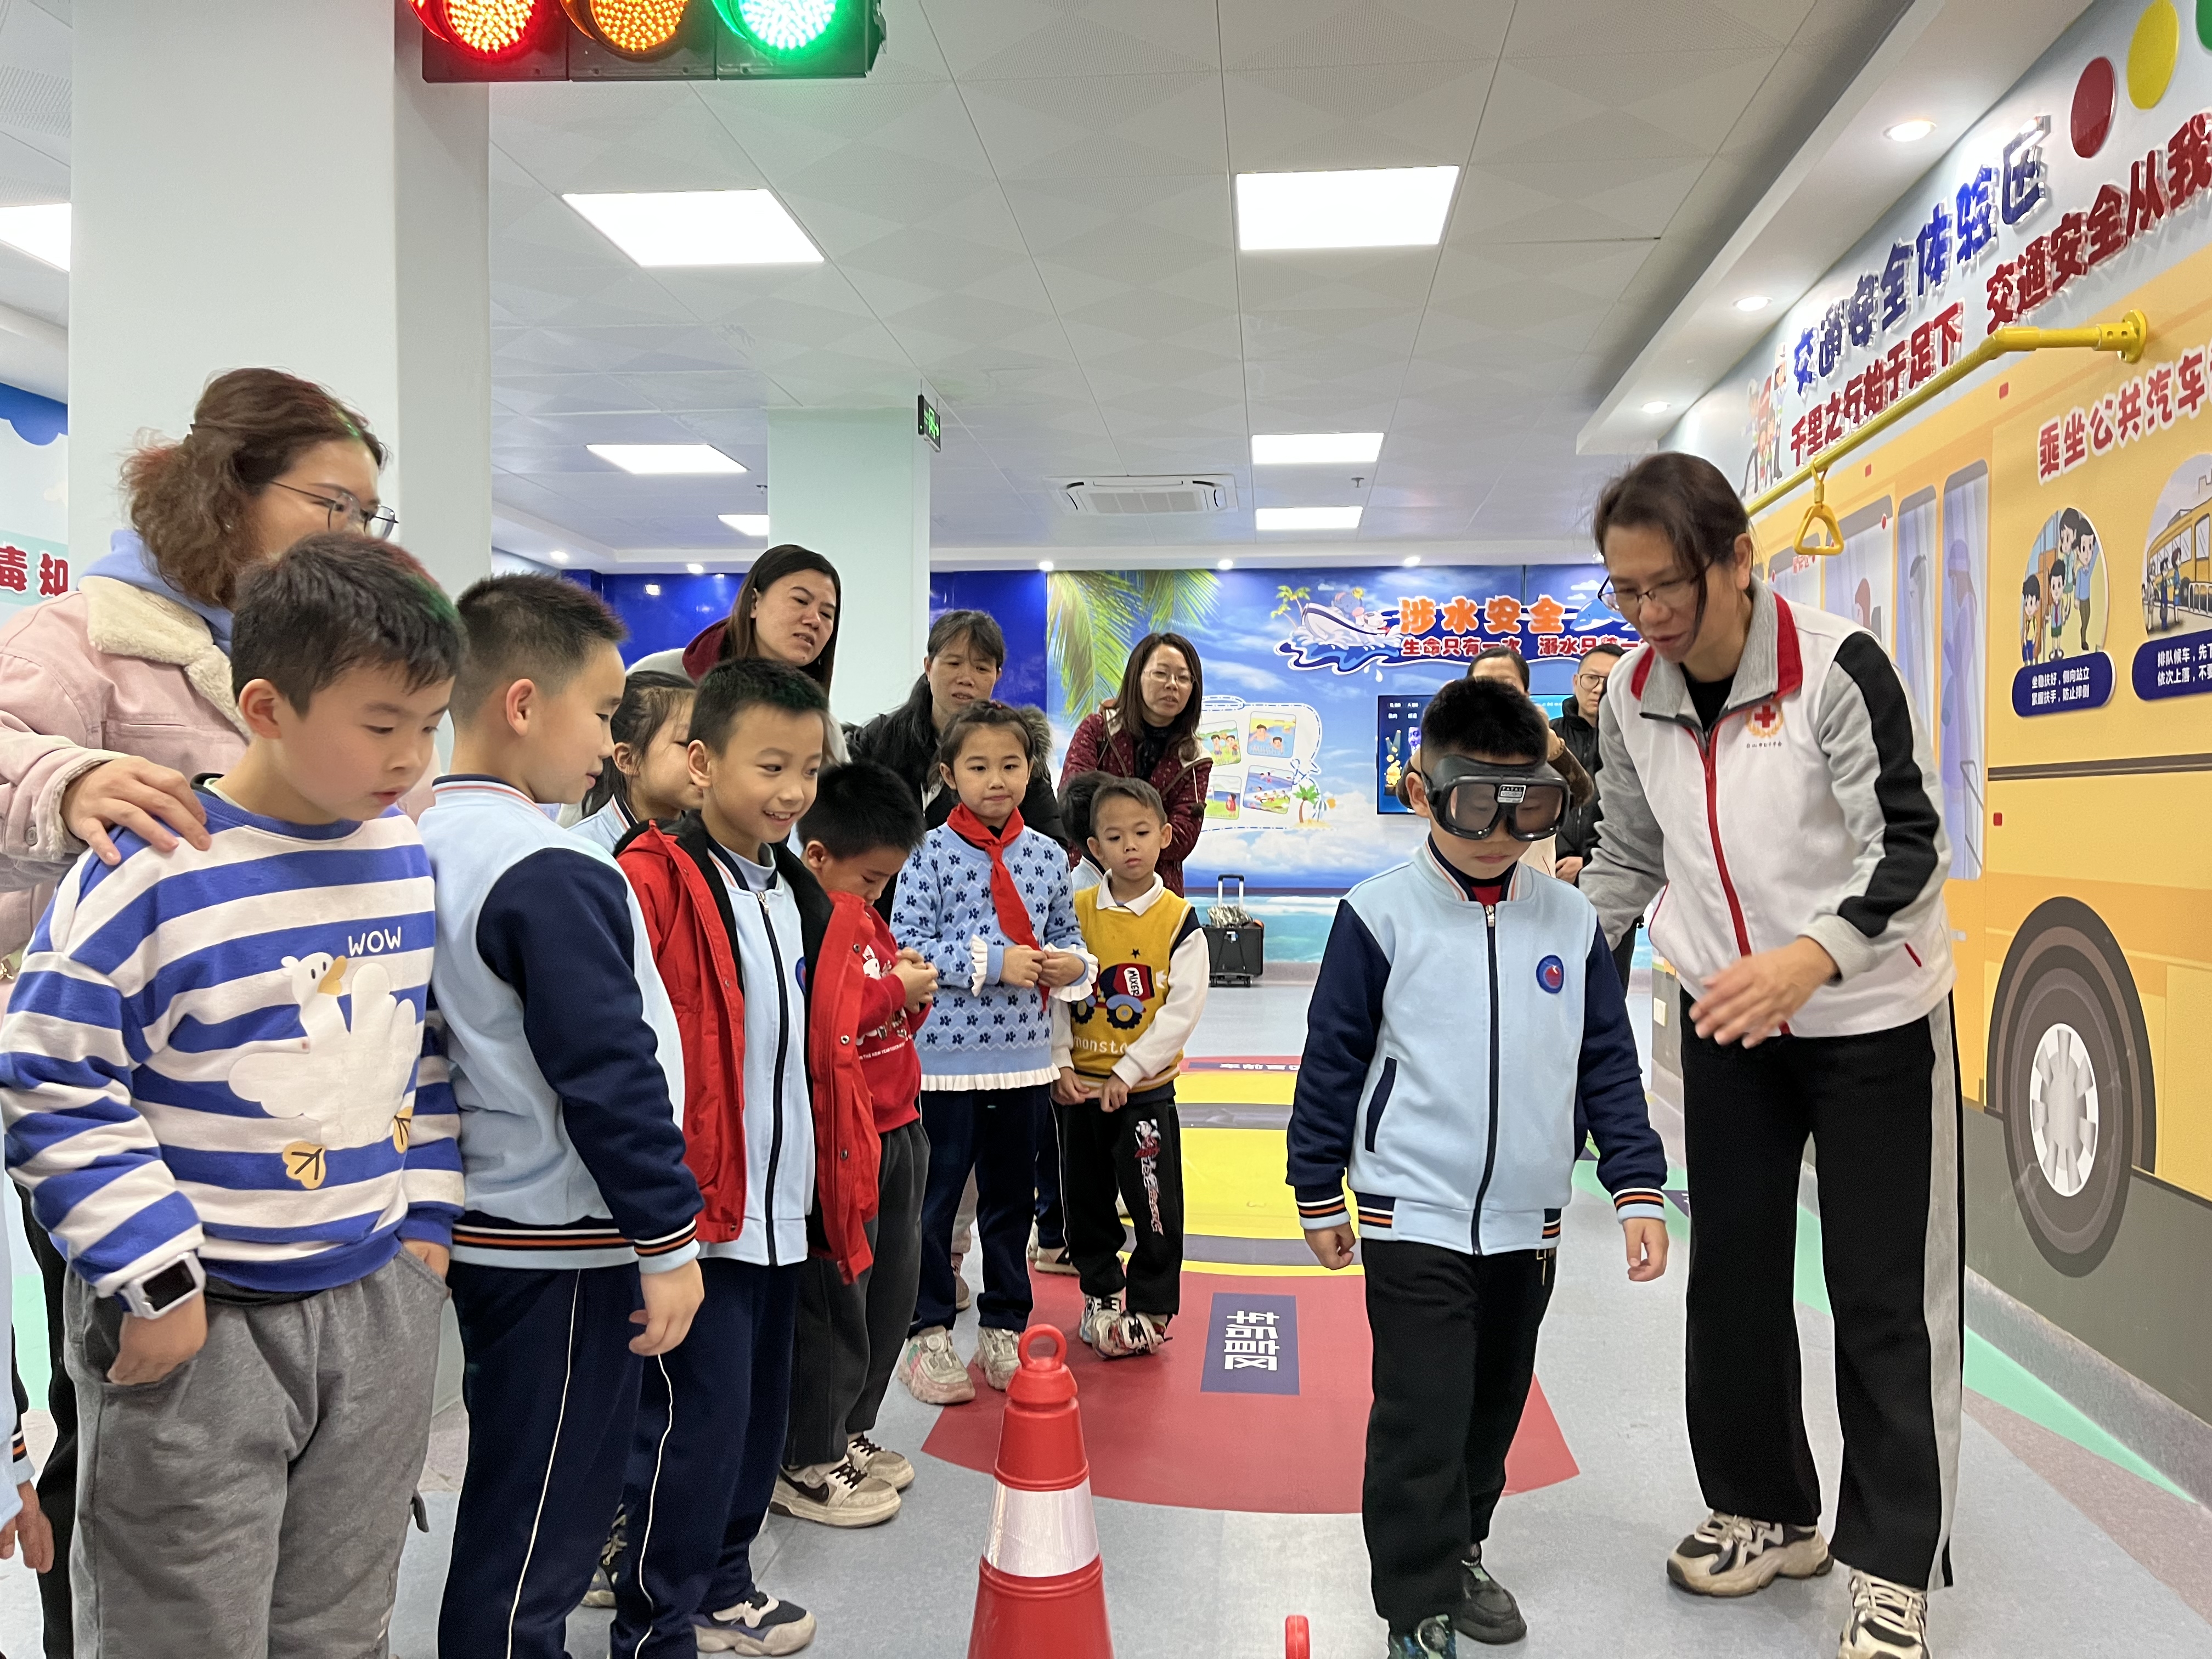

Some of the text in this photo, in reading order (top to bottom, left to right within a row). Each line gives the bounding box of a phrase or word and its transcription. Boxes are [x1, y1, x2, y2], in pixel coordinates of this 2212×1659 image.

[1794, 116, 2051, 396] 交通安全体验区
[1791, 302, 1965, 466] 千里之行始于足下
[2039, 347, 2212, 479] 乘坐公共汽车
[1400, 597, 1564, 634] 涉水安全
[1539, 637, 1645, 654] 溺水只一
[348, 926, 401, 957] WOW
[1127, 970, 1139, 996] MIXER
[1224, 1310, 1280, 1371] 车后盲区
